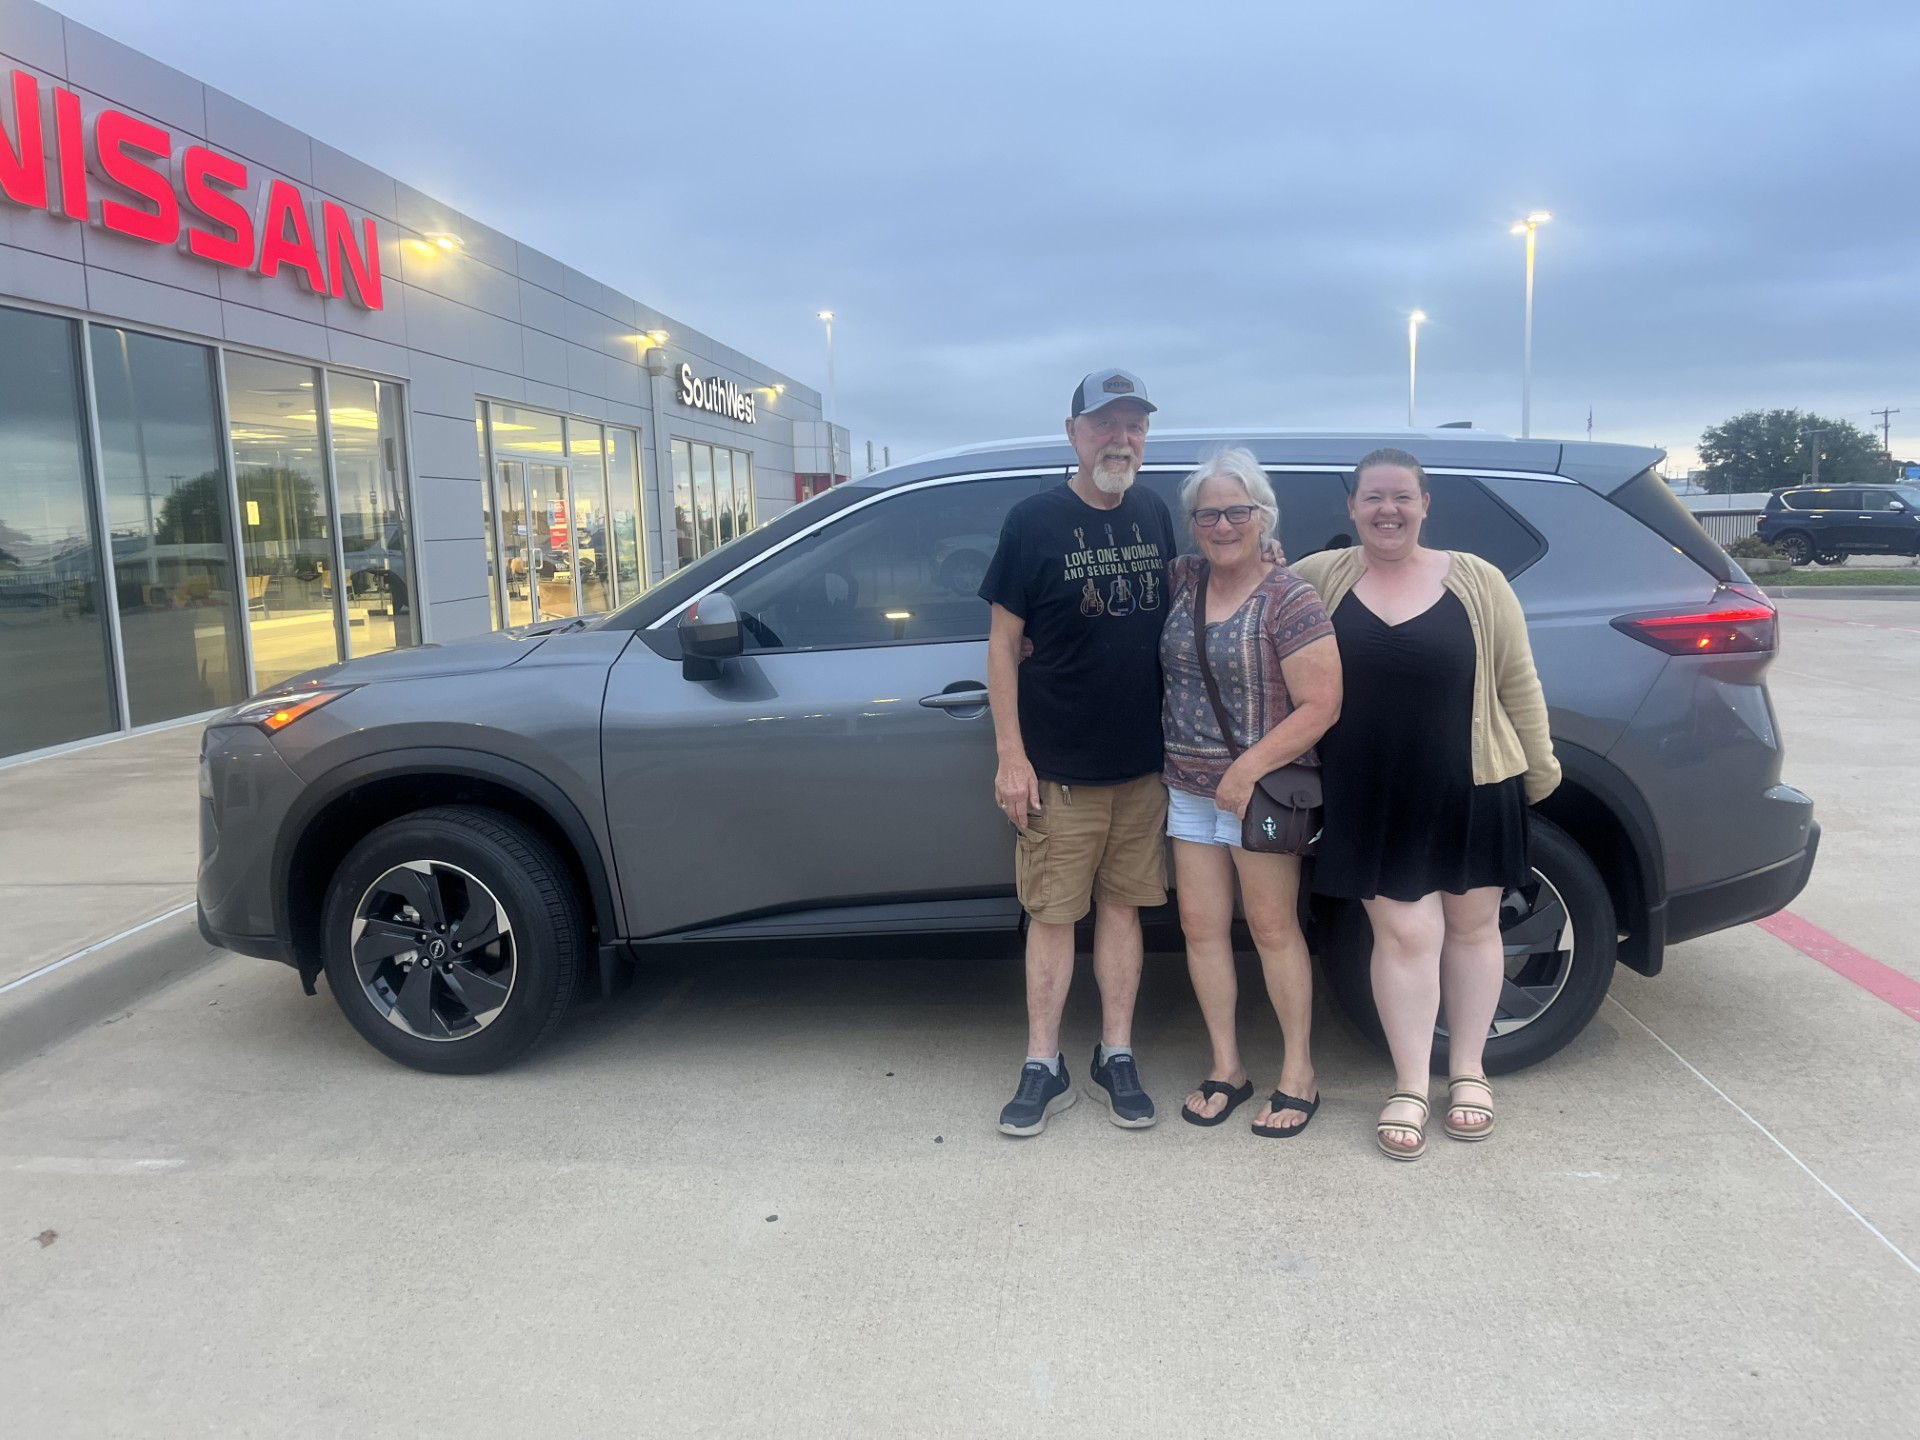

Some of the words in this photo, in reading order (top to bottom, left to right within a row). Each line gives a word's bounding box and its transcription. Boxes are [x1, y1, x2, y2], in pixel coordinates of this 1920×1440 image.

[681, 362, 757, 424] SouthWest
[1065, 550, 1094, 567] LOVE
[1097, 548, 1120, 563] ONE
[1121, 544, 1159, 560] WOMAN
[1064, 567, 1084, 581] AND
[1088, 563, 1129, 576] SEVERAL
